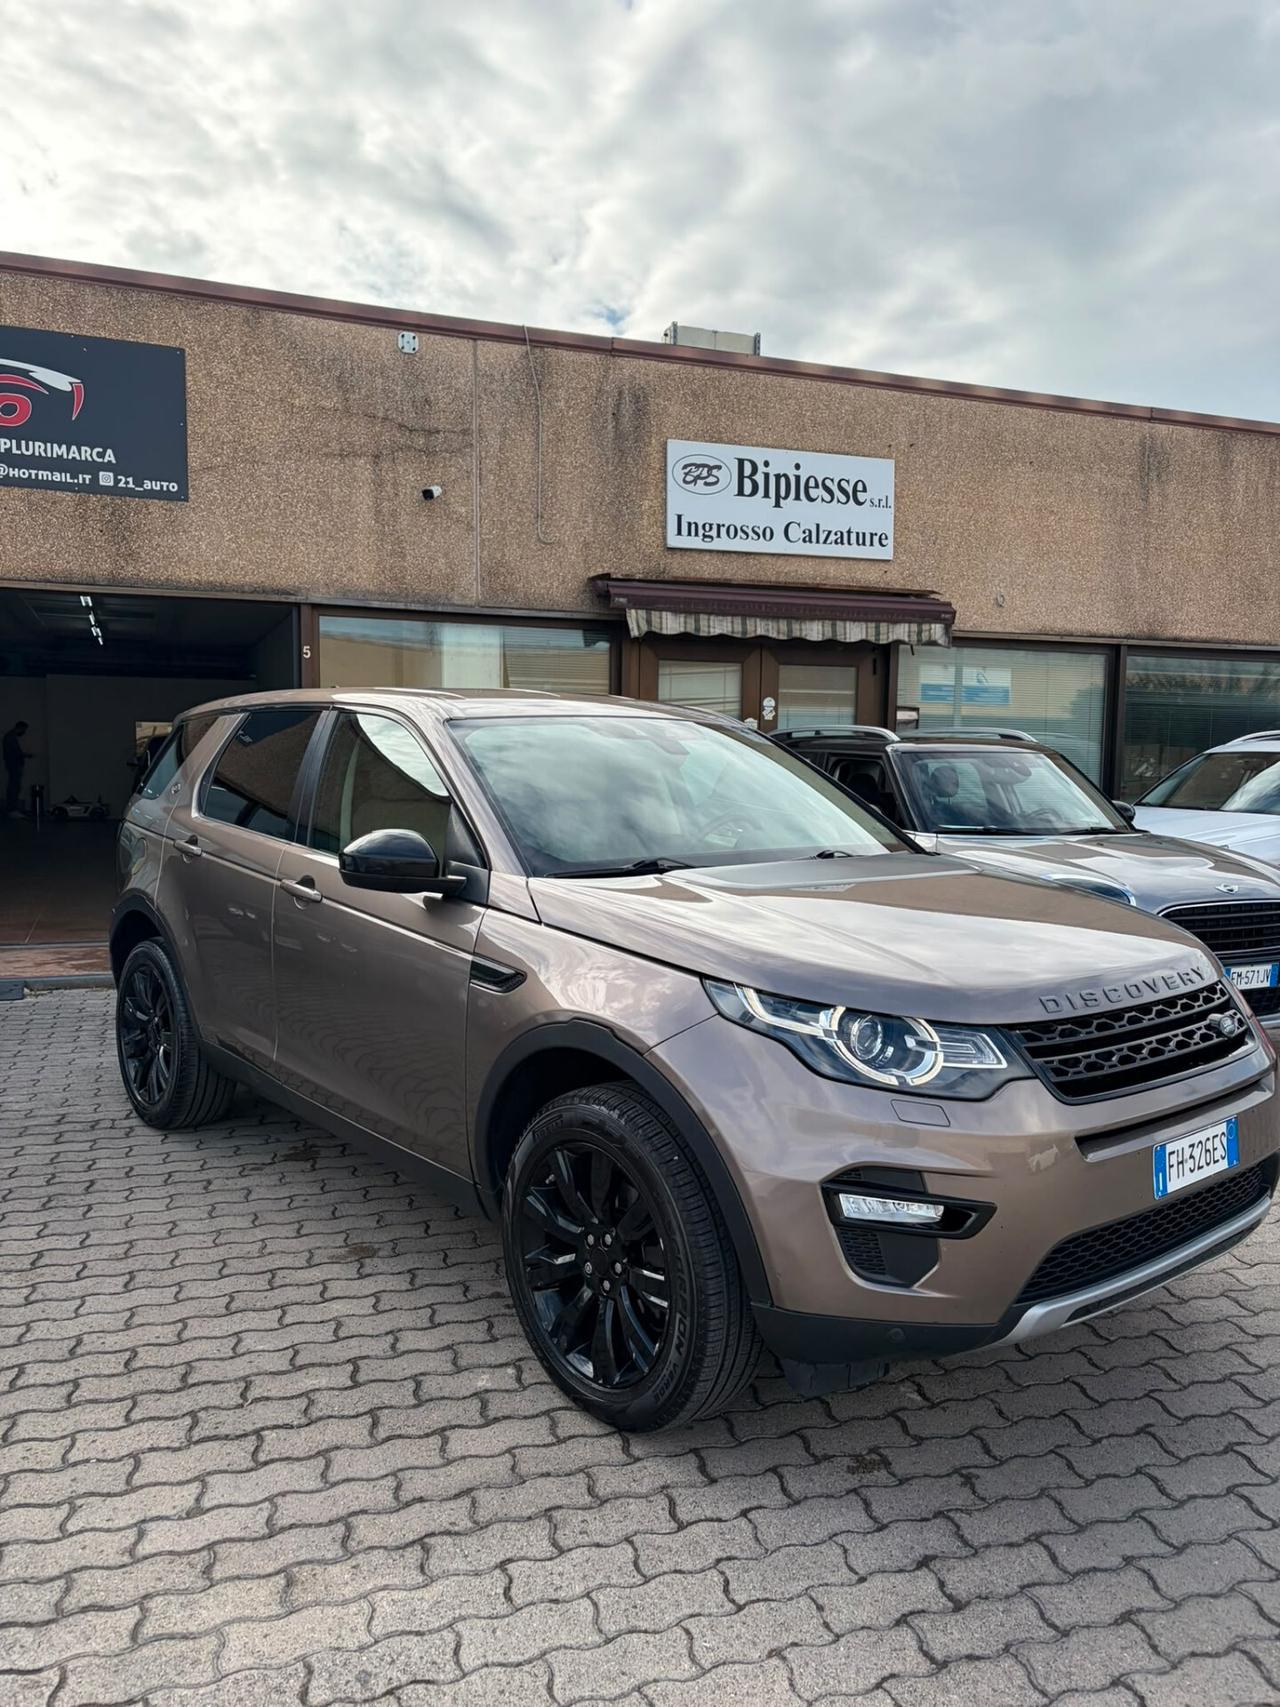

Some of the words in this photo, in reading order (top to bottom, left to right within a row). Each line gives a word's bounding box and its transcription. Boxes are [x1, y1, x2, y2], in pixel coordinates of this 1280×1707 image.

[0, 438, 117, 464] PLURIMARCA
[733, 457, 868, 509] Bipiesse
[869, 496, 892, 509] s.r.l.
[675, 513, 775, 543] Ingrosso
[783, 520, 889, 548] Calzature
[302, 645, 311, 659] 5
[1039, 965, 1207, 1014] DISCOVERY
